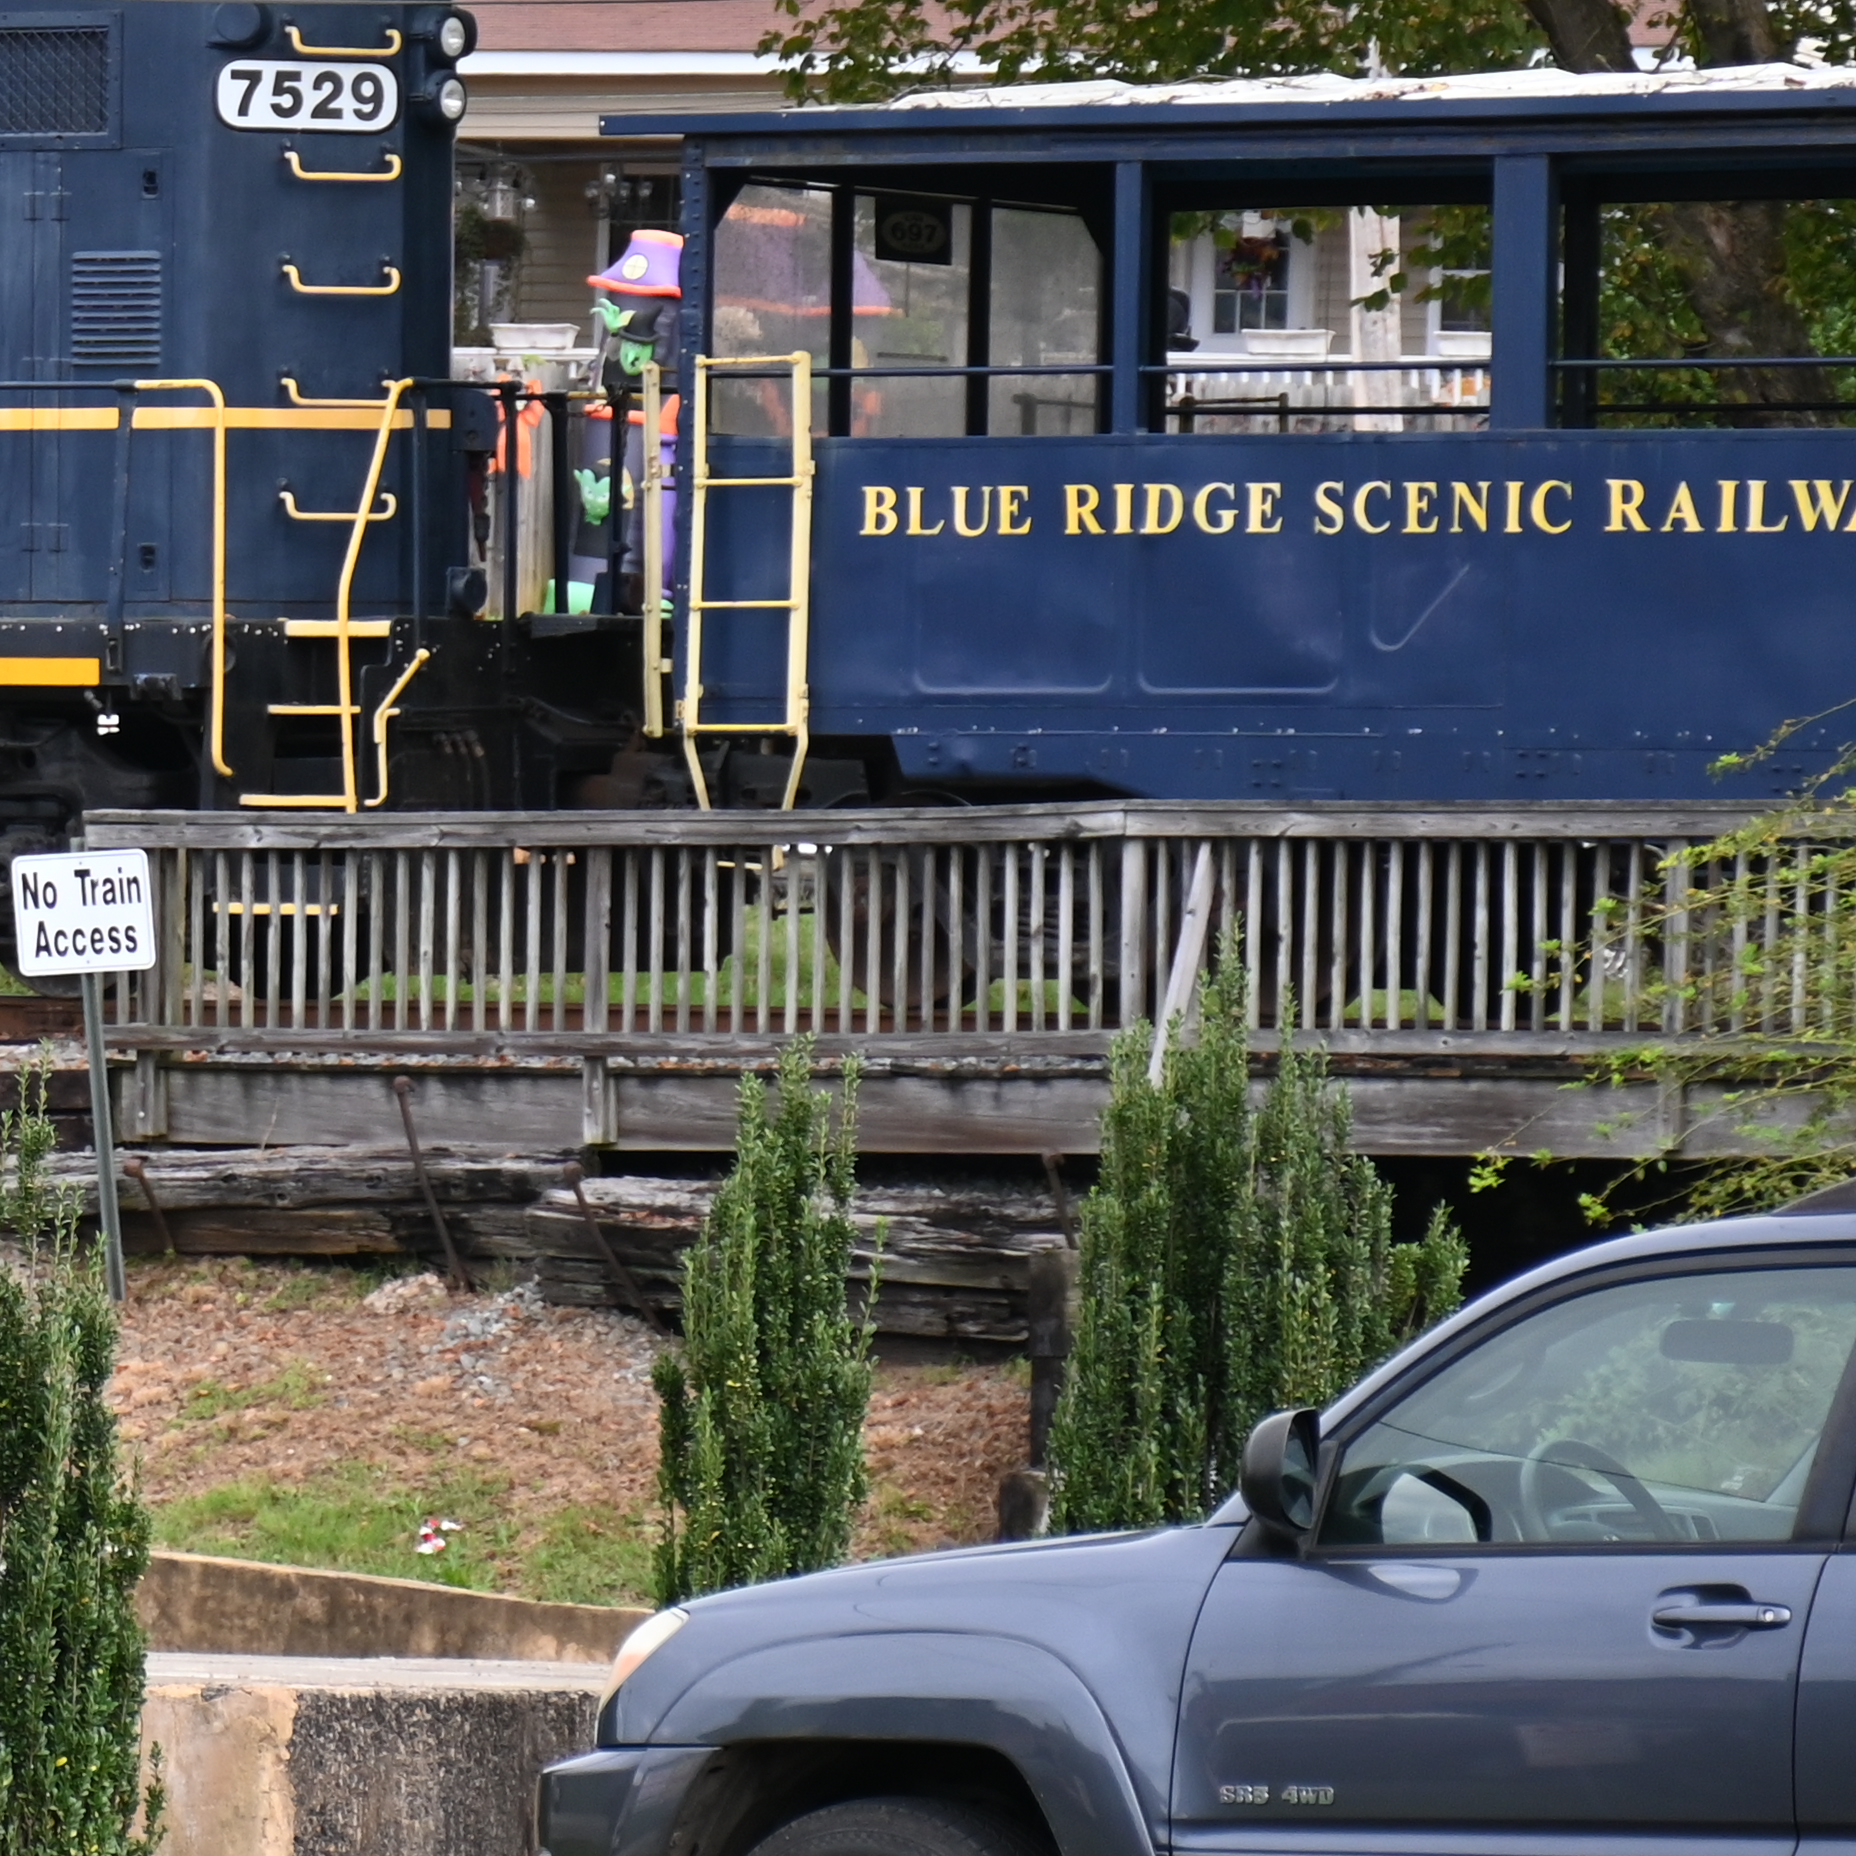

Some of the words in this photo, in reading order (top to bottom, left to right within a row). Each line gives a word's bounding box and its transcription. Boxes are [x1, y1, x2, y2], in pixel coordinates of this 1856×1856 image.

[229, 69, 384, 122] 7529
[859, 485, 1032, 537] BLUE
[1063, 482, 1284, 536] RIDGE
[1313, 480, 1573, 535] SCENIC
[1604, 479, 1856, 533] RAILW
[21, 872, 58, 910] No
[74, 867, 142, 906] Train
[35, 920, 138, 958] Access
[1219, 1785, 1269, 1804] SR5
[1281, 1785, 1334, 1804] 4WD
